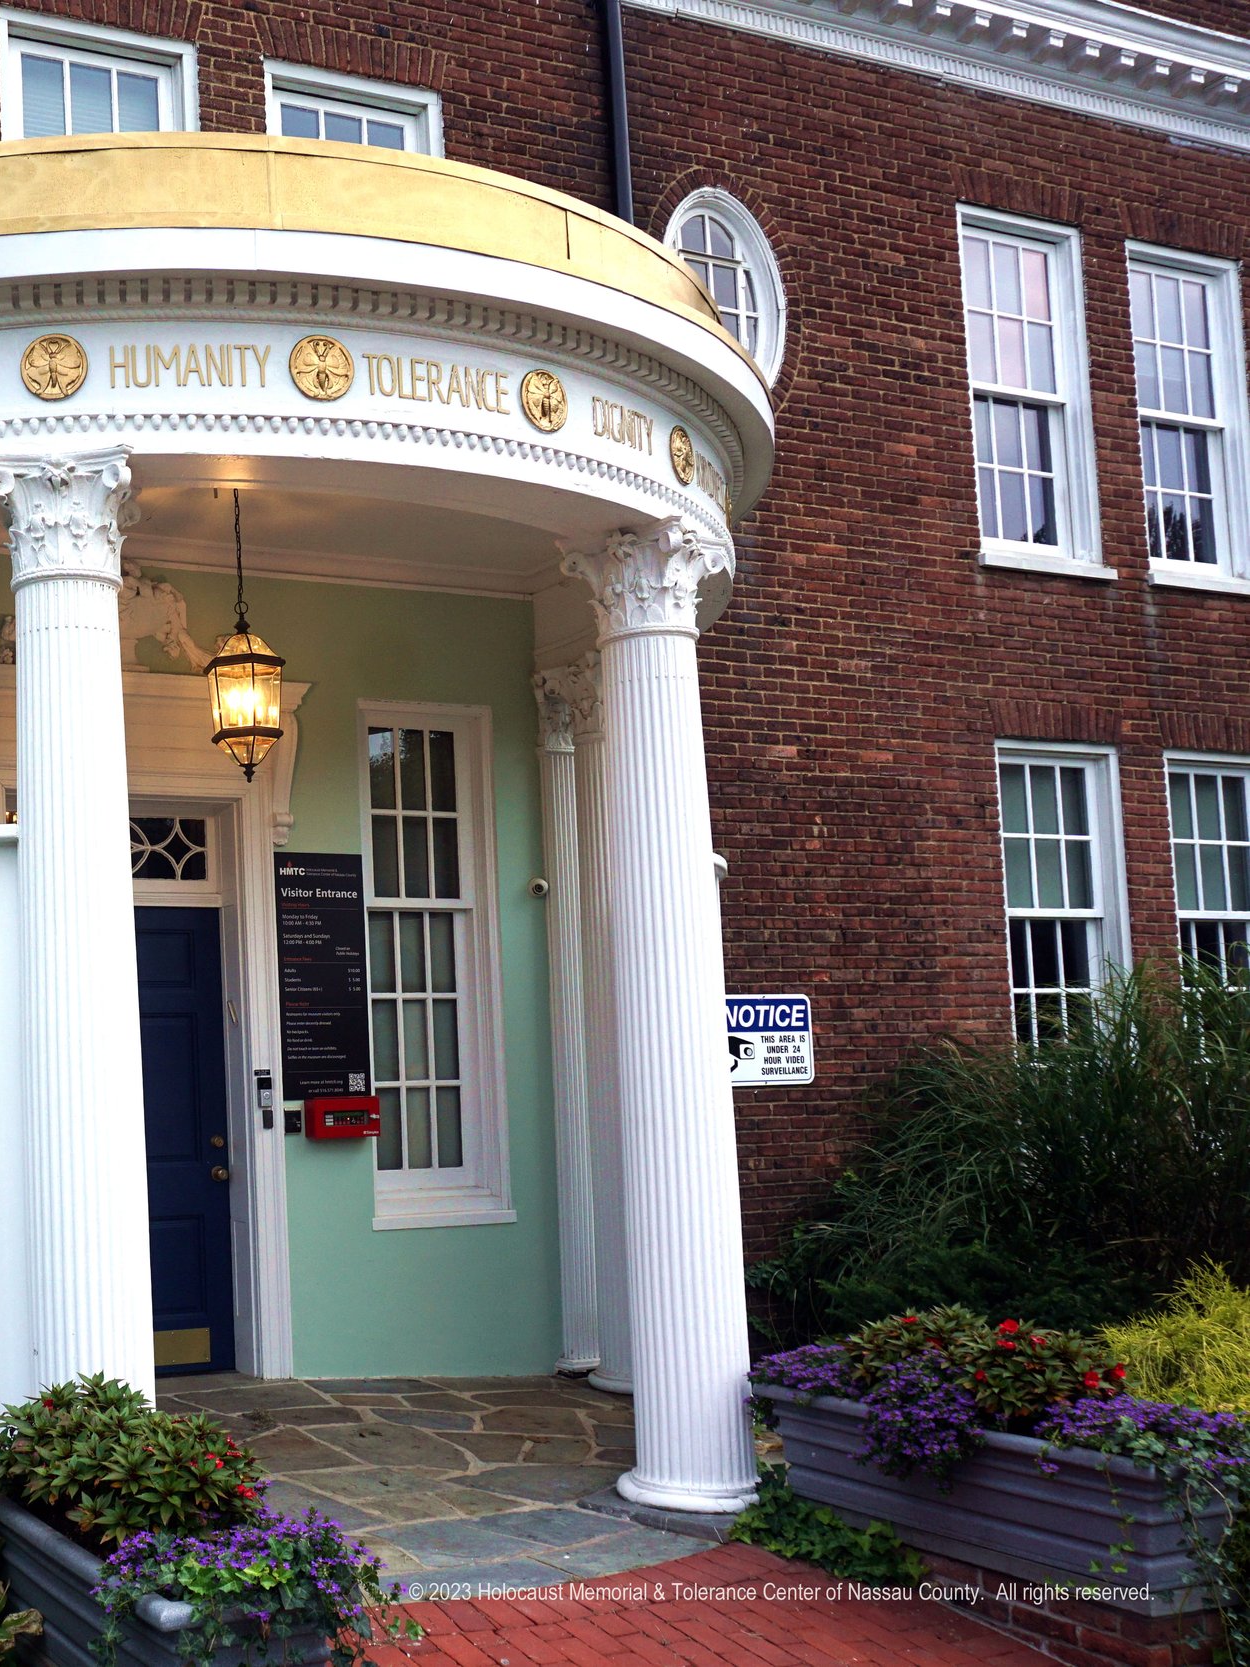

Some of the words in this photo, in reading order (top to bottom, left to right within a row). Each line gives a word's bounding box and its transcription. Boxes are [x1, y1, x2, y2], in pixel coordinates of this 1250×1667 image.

[109, 343, 271, 388] HUMANITY
[362, 353, 511, 415] TOLERANCE
[592, 396, 654, 456] DIGNITY
[279, 867, 306, 876] HMTC
[280, 887, 314, 898] Visitor
[315, 888, 358, 899] Entrance
[725, 1004, 806, 1028] NOTICE
[760, 1035, 775, 1043] THIS
[778, 1035, 796, 1043] AREA
[766, 1045, 789, 1054] UNDER
[792, 1045, 801, 1053] 24
[763, 1056, 782, 1064] HOUR
[785, 1055, 805, 1064] VIDEO
[761, 1066, 808, 1075] SURVEILLANCE
